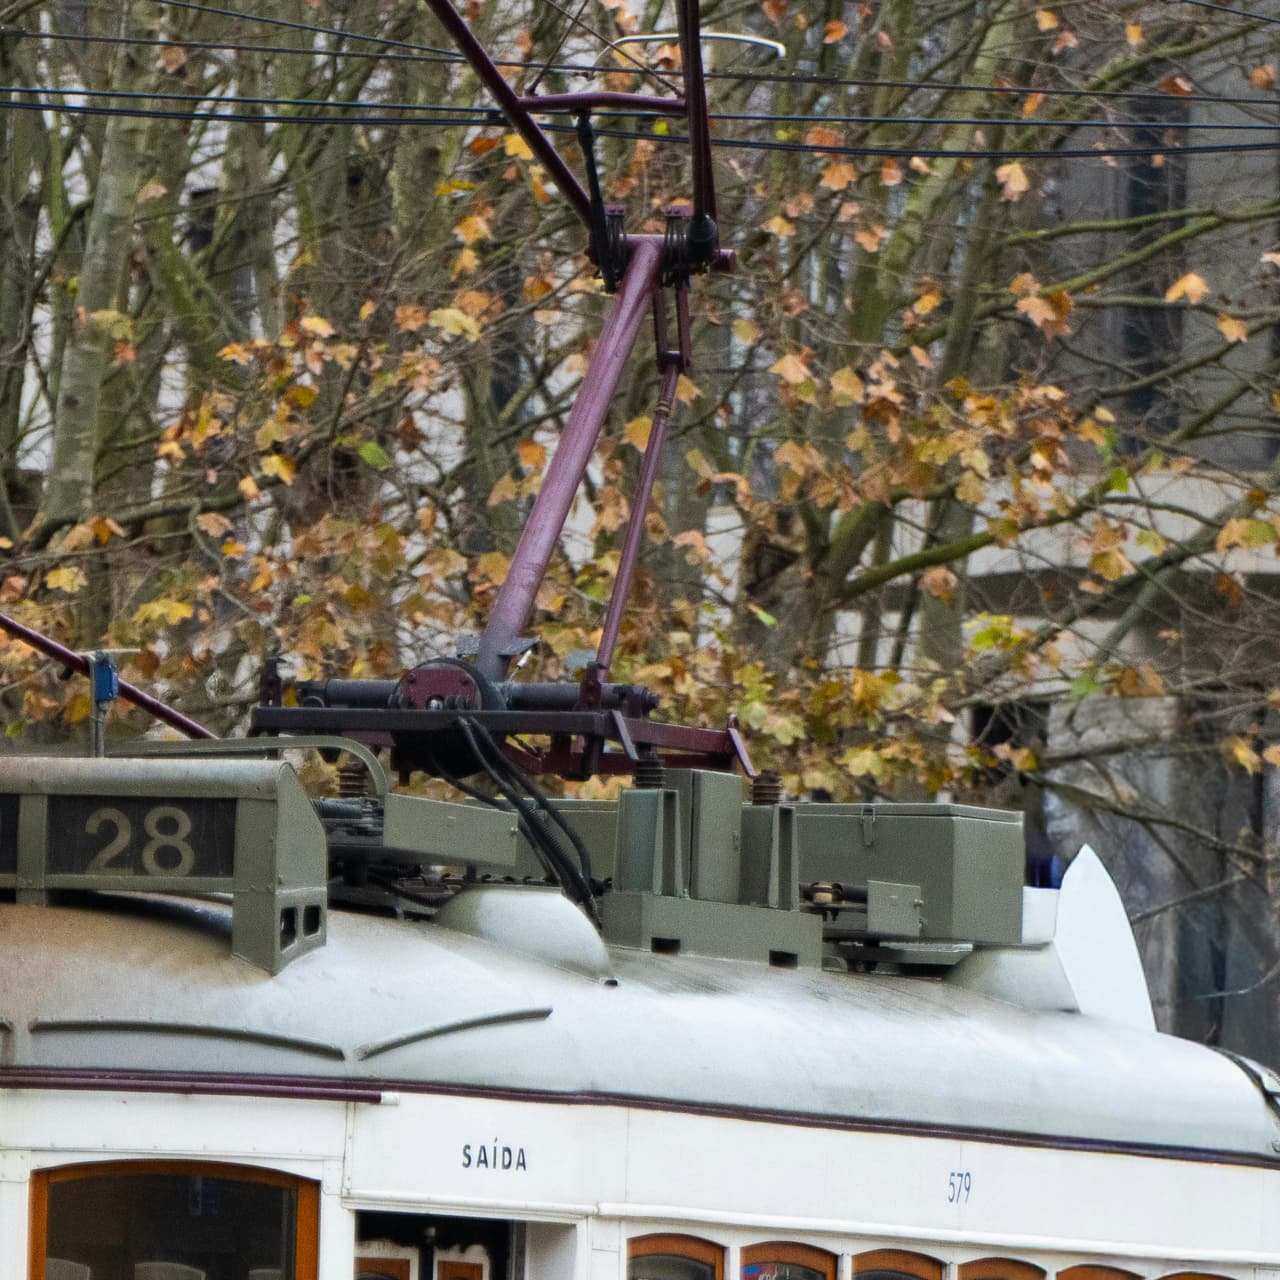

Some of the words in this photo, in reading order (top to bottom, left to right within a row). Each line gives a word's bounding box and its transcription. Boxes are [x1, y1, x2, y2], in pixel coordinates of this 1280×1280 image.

[84, 806, 195, 877] 28
[462, 1136, 527, 1171] SAÍDA
[948, 1171, 972, 1204] 579
